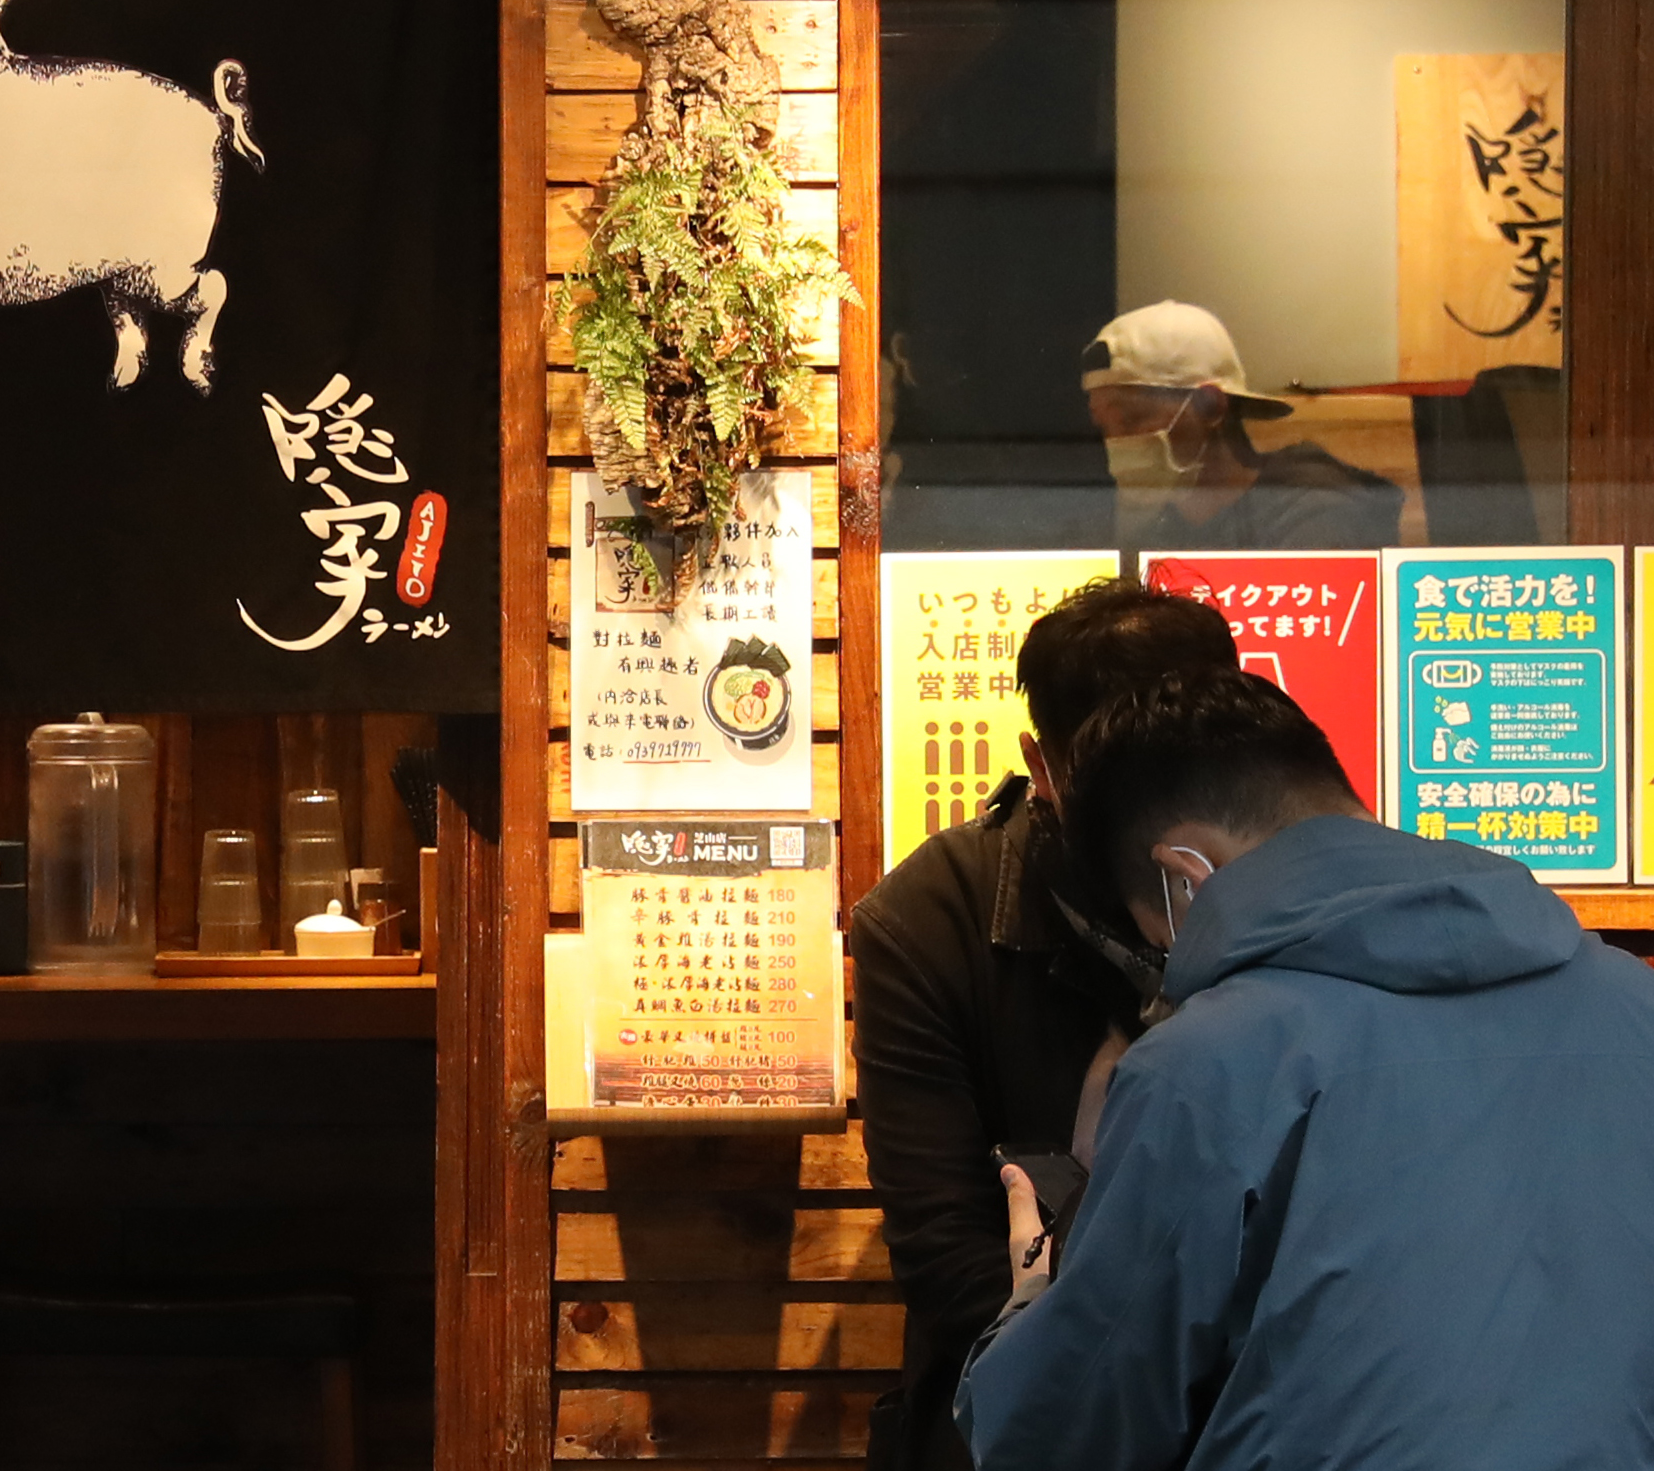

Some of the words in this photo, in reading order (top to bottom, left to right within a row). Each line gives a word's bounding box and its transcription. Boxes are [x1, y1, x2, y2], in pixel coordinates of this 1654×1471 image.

[405, 500, 435, 598] AJITO
[360, 607, 451, 644] ラーメン
[1229, 616, 1332, 638] ってます!
[1412, 611, 1597, 642] 元気に営業中
[592, 628, 662, 649] 對拉麵
[917, 631, 1027, 661] 入店制
[1416, 781, 1597, 809] 安全確保の為に
[1416, 810, 1599, 841] 精一杯対策中
[693, 844, 758, 862] MENU
[767, 888, 795, 903] 180
[767, 911, 795, 925] 210
[768, 933, 796, 947] 190
[767, 955, 796, 970] 250
[767, 977, 797, 992] 280
[767, 1000, 797, 1014] 270
[767, 1031, 796, 1044] 100
[701, 1055, 721, 1068] 50
[777, 1055, 797, 1068] 50
[701, 1075, 722, 1088] 60
[776, 1075, 798, 1088] 20
